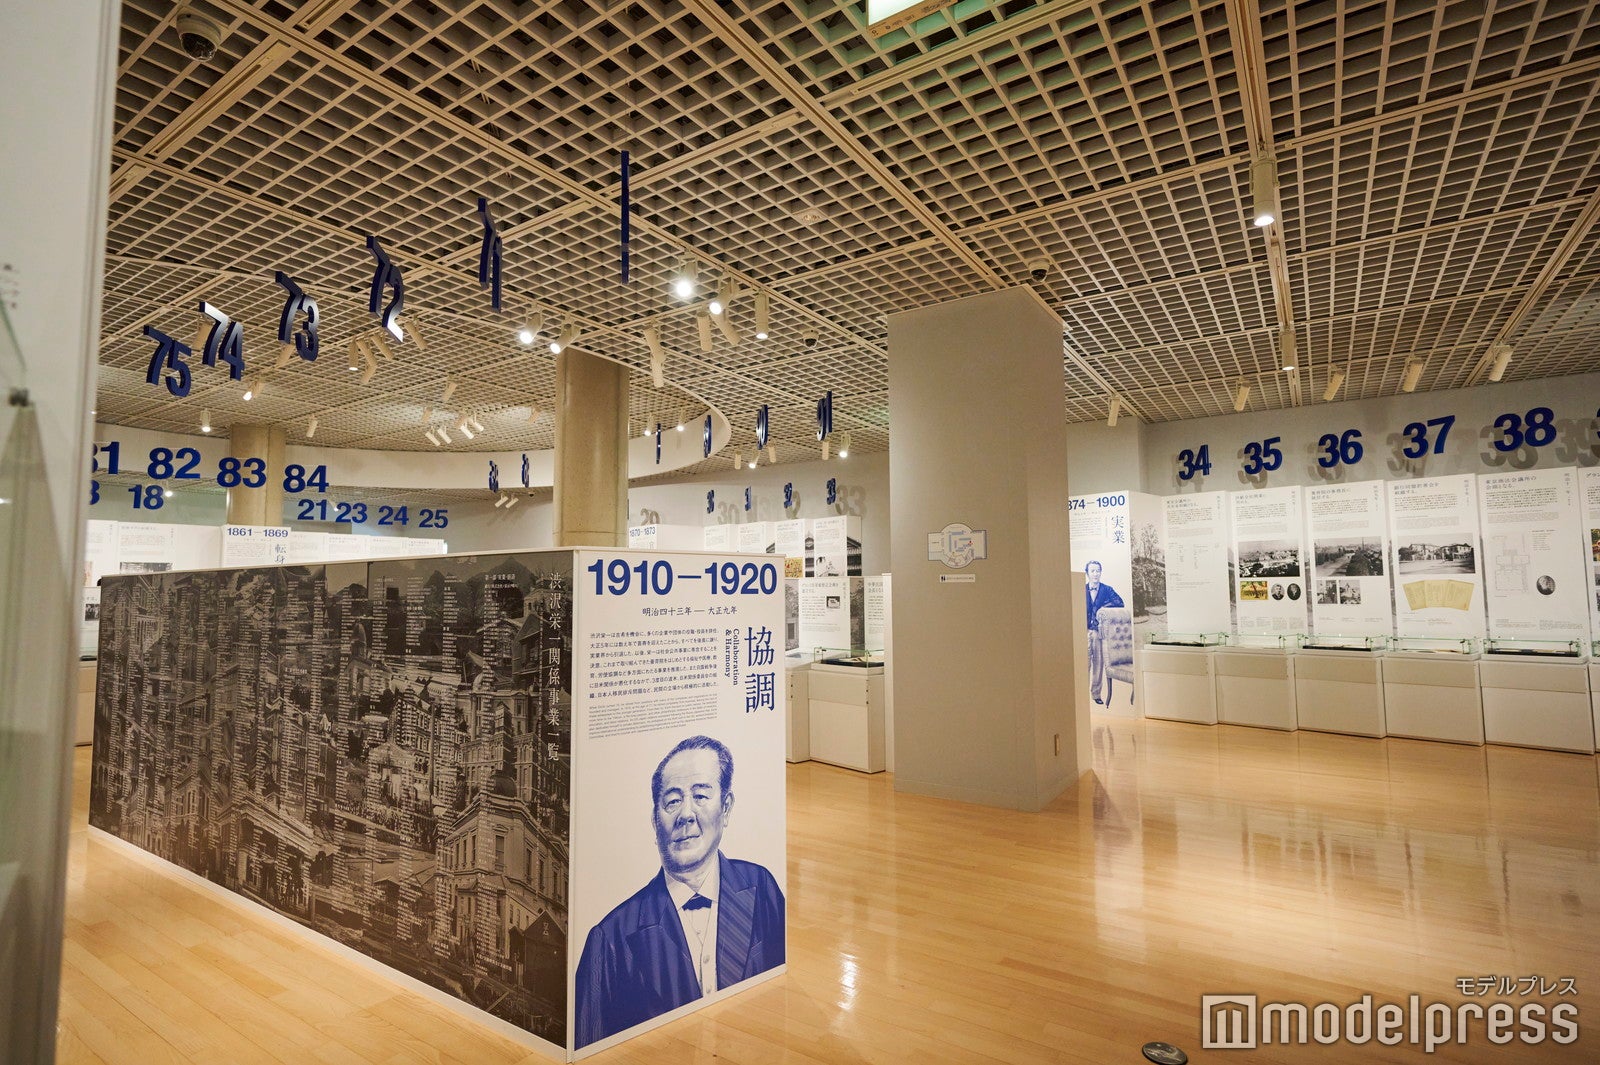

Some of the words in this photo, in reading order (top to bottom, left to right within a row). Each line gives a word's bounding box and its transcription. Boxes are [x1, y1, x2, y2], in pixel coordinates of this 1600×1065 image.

[275, 271, 319, 362] 73
[200, 302, 245, 381] 74
[143, 325, 192, 398] 75
[1402, 415, 1456, 459] 37
[1493, 407, 1557, 452] 38
[147, 447, 201, 479] 82
[1179, 444, 1212, 480] 34
[1244, 436, 1283, 475] 35
[1318, 429, 1364, 468] 36
[216, 457, 266, 488] 83
[282, 464, 329, 493] 84
[128, 484, 164, 510] 18
[297, 498, 327, 521] 21
[335, 502, 368, 524] 23
[1068, 495, 1126, 510] 874—1900
[378, 505, 409, 526] 24
[419, 508, 448, 529] 25
[1110, 515, 1125, 543] 実業
[725, 629, 732, 637] &
[548, 572, 561, 761] 渋沢栄一関係事業一覧
[744, 626, 775, 713] 協調
